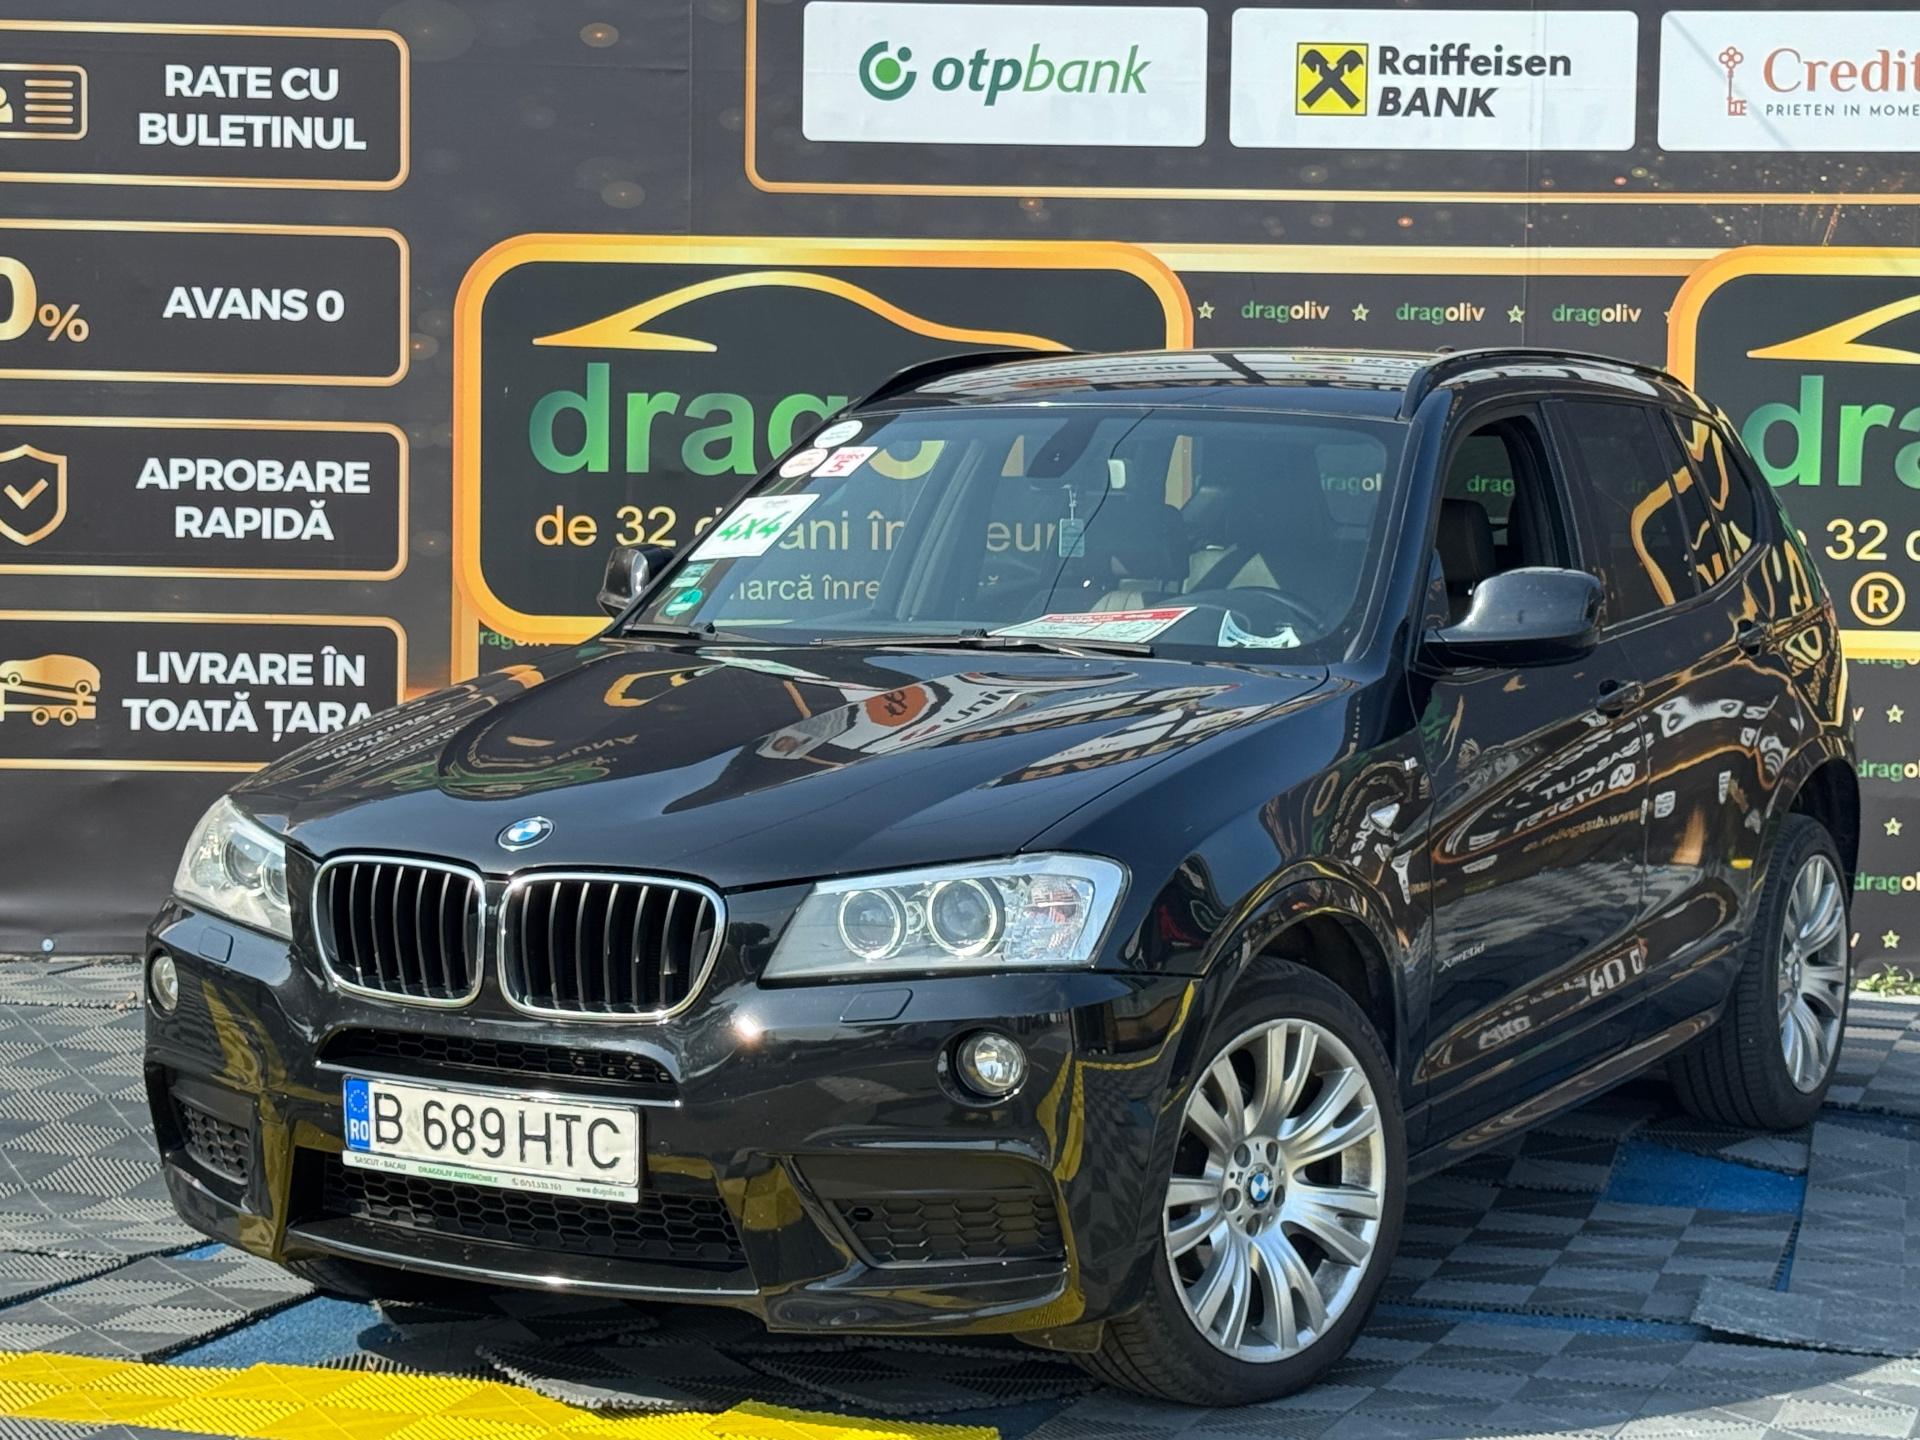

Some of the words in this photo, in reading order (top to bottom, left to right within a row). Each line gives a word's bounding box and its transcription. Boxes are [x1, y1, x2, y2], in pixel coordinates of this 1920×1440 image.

[932, 43, 1151, 106] otpbank
[1378, 43, 1571, 79] Raiffeisen
[165, 64, 272, 99] RATE
[281, 67, 340, 101] CU
[1378, 86, 1498, 118] BANK
[1766, 104, 1834, 116] PRIETEN
[1844, 104, 1860, 116] IN
[1870, 104, 1920, 117] MOME
[139, 111, 366, 150] BULETINUL
[163, 286, 308, 321] AVANS
[317, 289, 345, 323] 0
[1241, 301, 1329, 320] dragoliv
[1396, 302, 1485, 323] dragoliv
[1552, 303, 1641, 324] dragoliv
[135, 457, 371, 494] APROBARE
[175, 500, 334, 541] RAPIDĂ
[535, 505, 597, 547] de
[615, 507, 677, 548] 32
[1825, 518, 1888, 561] 32
[136, 651, 314, 686] LIVRARE
[320, 645, 365, 687] ÎN
[121, 691, 258, 732] TOATĂ
[350, 1118, 370, 1141] RO
[374, 1092, 403, 1144] B
[423, 1100, 506, 1158] 689
[518, 1110, 621, 1170] HTC
